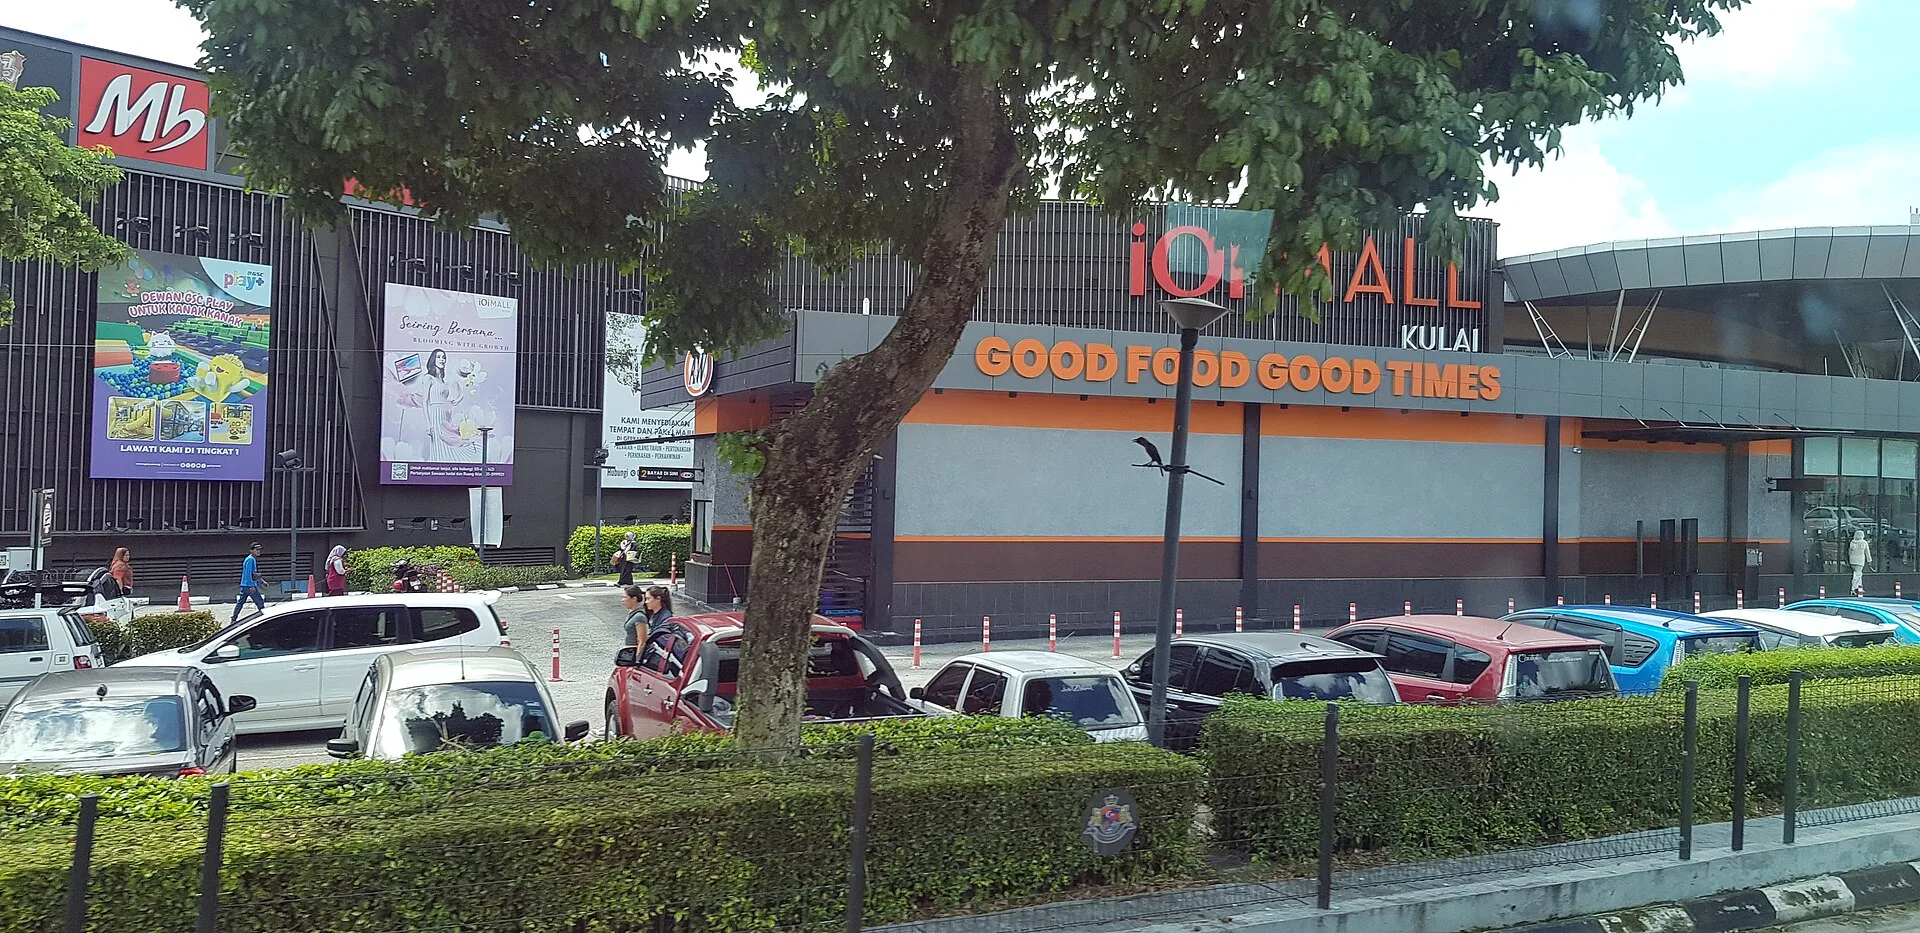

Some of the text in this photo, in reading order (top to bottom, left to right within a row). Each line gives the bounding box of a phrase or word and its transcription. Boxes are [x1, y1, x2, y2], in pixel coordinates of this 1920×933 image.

[141, 291, 234, 313] DEWAN GSC PLAY
[129, 303, 244, 328] UNTUK KANAK KANAK
[399, 315, 443, 336] Seiring
[412, 337, 454, 346] BLOOMING
[1402, 325, 1479, 352] KULAI
[975, 336, 1502, 401] GOOD FOOD GOOD TIMES
[620, 416, 690, 427] KAMI MENYEDIAKAN
[609, 425, 636, 434] TEMPAT
[636, 427, 653, 435] DAN
[120, 444, 158, 453] LAWATI
[159, 446, 183, 454] KAMI
[197, 447, 234, 455] TINGKAT
[235, 448, 240, 456] 1
[641, 469, 647, 478] 2
